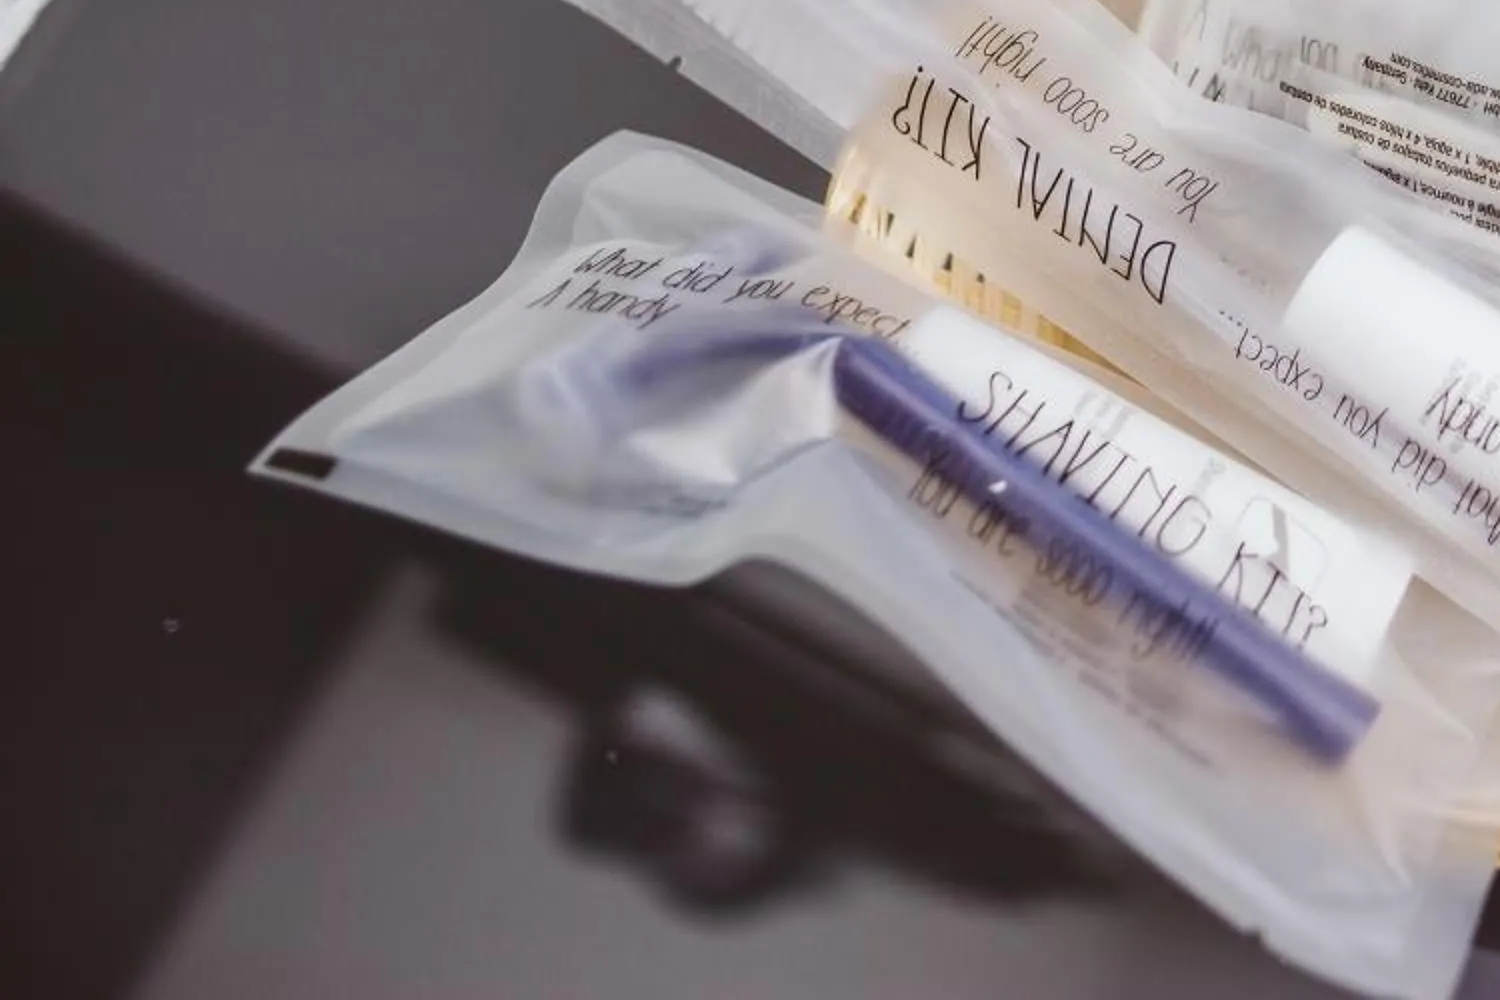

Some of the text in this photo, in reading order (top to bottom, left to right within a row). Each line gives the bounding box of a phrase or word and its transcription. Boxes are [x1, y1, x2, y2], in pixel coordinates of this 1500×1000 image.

[954, 14, 1046, 88] right!
[1041, 74, 1110, 135] sooo
[1108, 133, 1165, 174] are
[889, 65, 1174, 306] DENTAL KIT?
[1163, 165, 1220, 223] You
[573, 247, 664, 279] What
[661, 260, 734, 293] did
[721, 279, 794, 303] you
[565, 279, 681, 329] handy
[1331, 392, 1388, 448] you
[1390, 436, 1450, 493] did
[956, 371, 1329, 653] SHAVING KIT?
